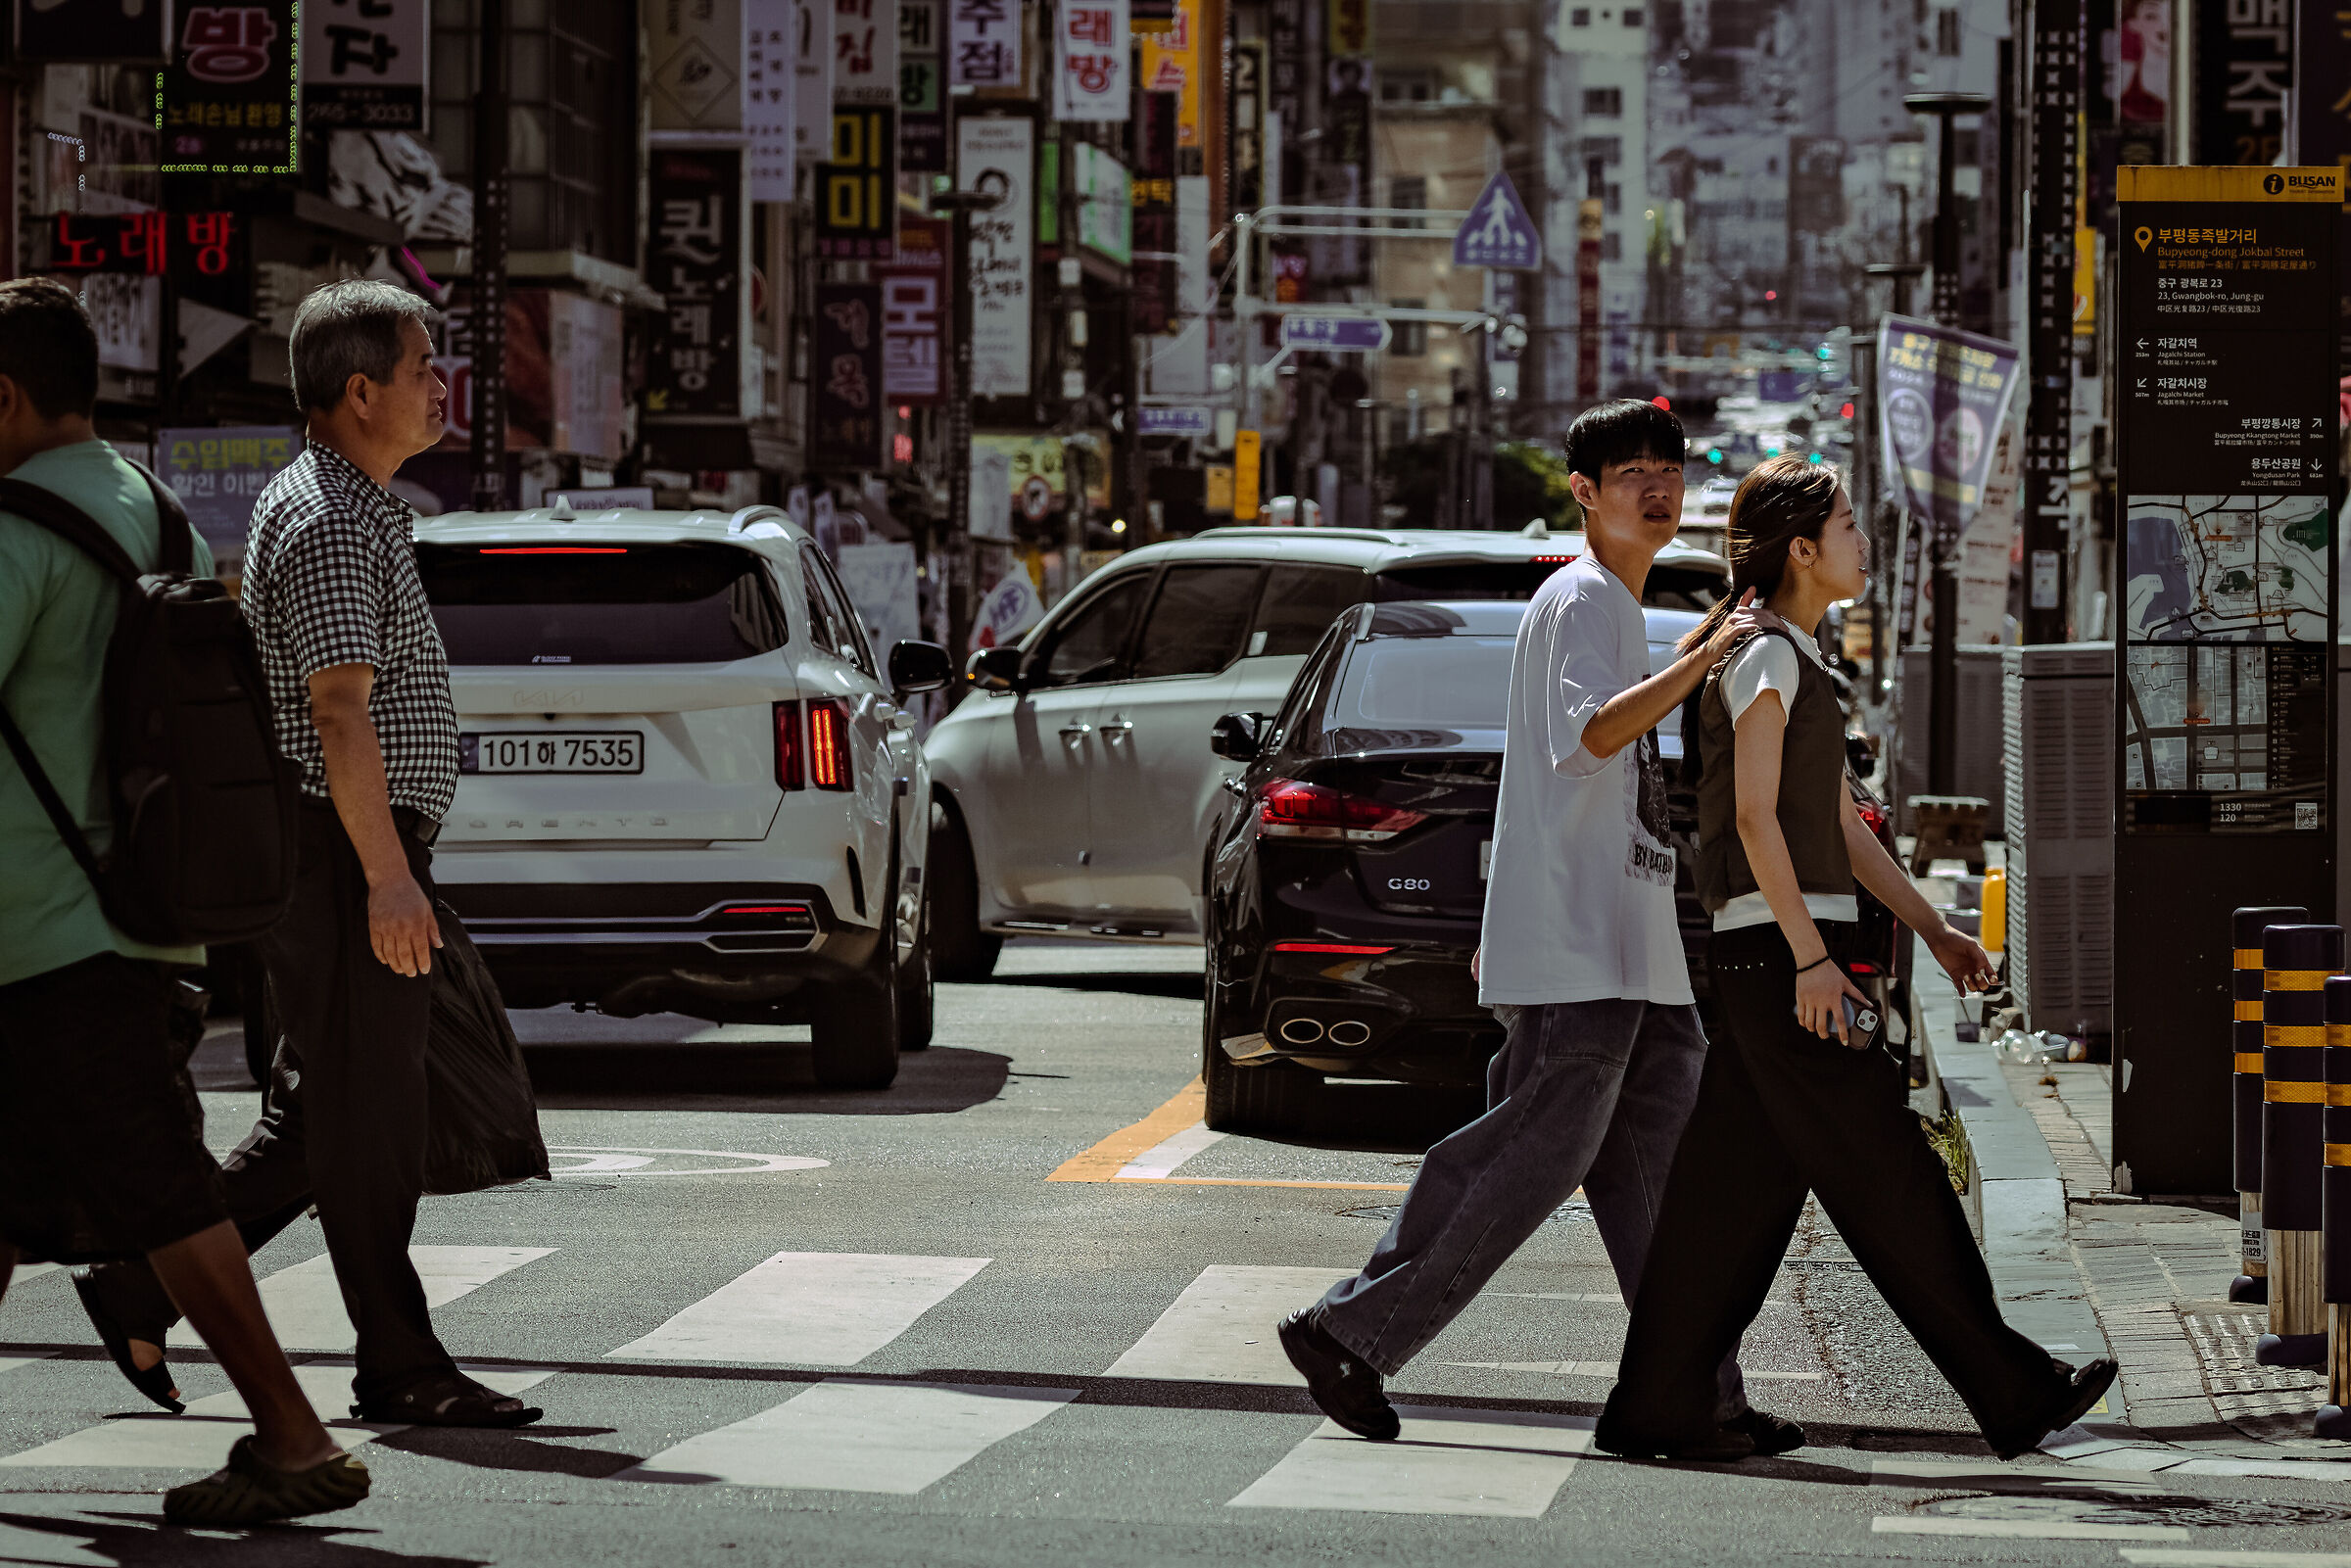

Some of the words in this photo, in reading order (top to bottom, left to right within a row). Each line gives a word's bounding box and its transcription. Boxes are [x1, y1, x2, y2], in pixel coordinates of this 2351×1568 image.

[181, 7, 278, 84] 방
[167, 101, 243, 127] 노래손님
[246, 101, 283, 128] 환영
[828, 112, 883, 231] 미미
[2288, 175, 2336, 188] BUSAN
[2158, 228, 2257, 244] 부평동족발거리
[52, 211, 236, 275] 노래방
[2158, 247, 2237, 260] Bupyeong-dong
[2240, 247, 2273, 258] Jokbal
[2275, 247, 2304, 258] Street
[2158, 278, 2176, 289] 중구
[2180, 278, 2208, 289] 광복로
[2211, 279, 2223, 288] 23
[2158, 293, 2171, 302] 23,
[2172, 292, 2229, 302] Gwangbok-ro,
[2231, 292, 2264, 303] Jung-gu
[668, 264, 719, 392] 노래방
[883, 275, 939, 394] 모텔
[2158, 337, 2197, 350] 자갈치역
[2158, 377, 2207, 390] 자갈치시장
[2241, 417, 2301, 430] 부평깡통시장
[169, 437, 291, 471] 수입맥주
[2251, 457, 2301, 470] 용두산공원
[2252, 471, 2285, 480] Yongdusan
[484, 739, 556, 768] 101하
[564, 739, 634, 767] 7535
[2219, 802, 2242, 812] 1330
[440, 817, 668, 829] ORENTO
[2219, 813, 2236, 823] 120
[1634, 843, 1648, 868] BY
[1387, 878, 1430, 890] G80
